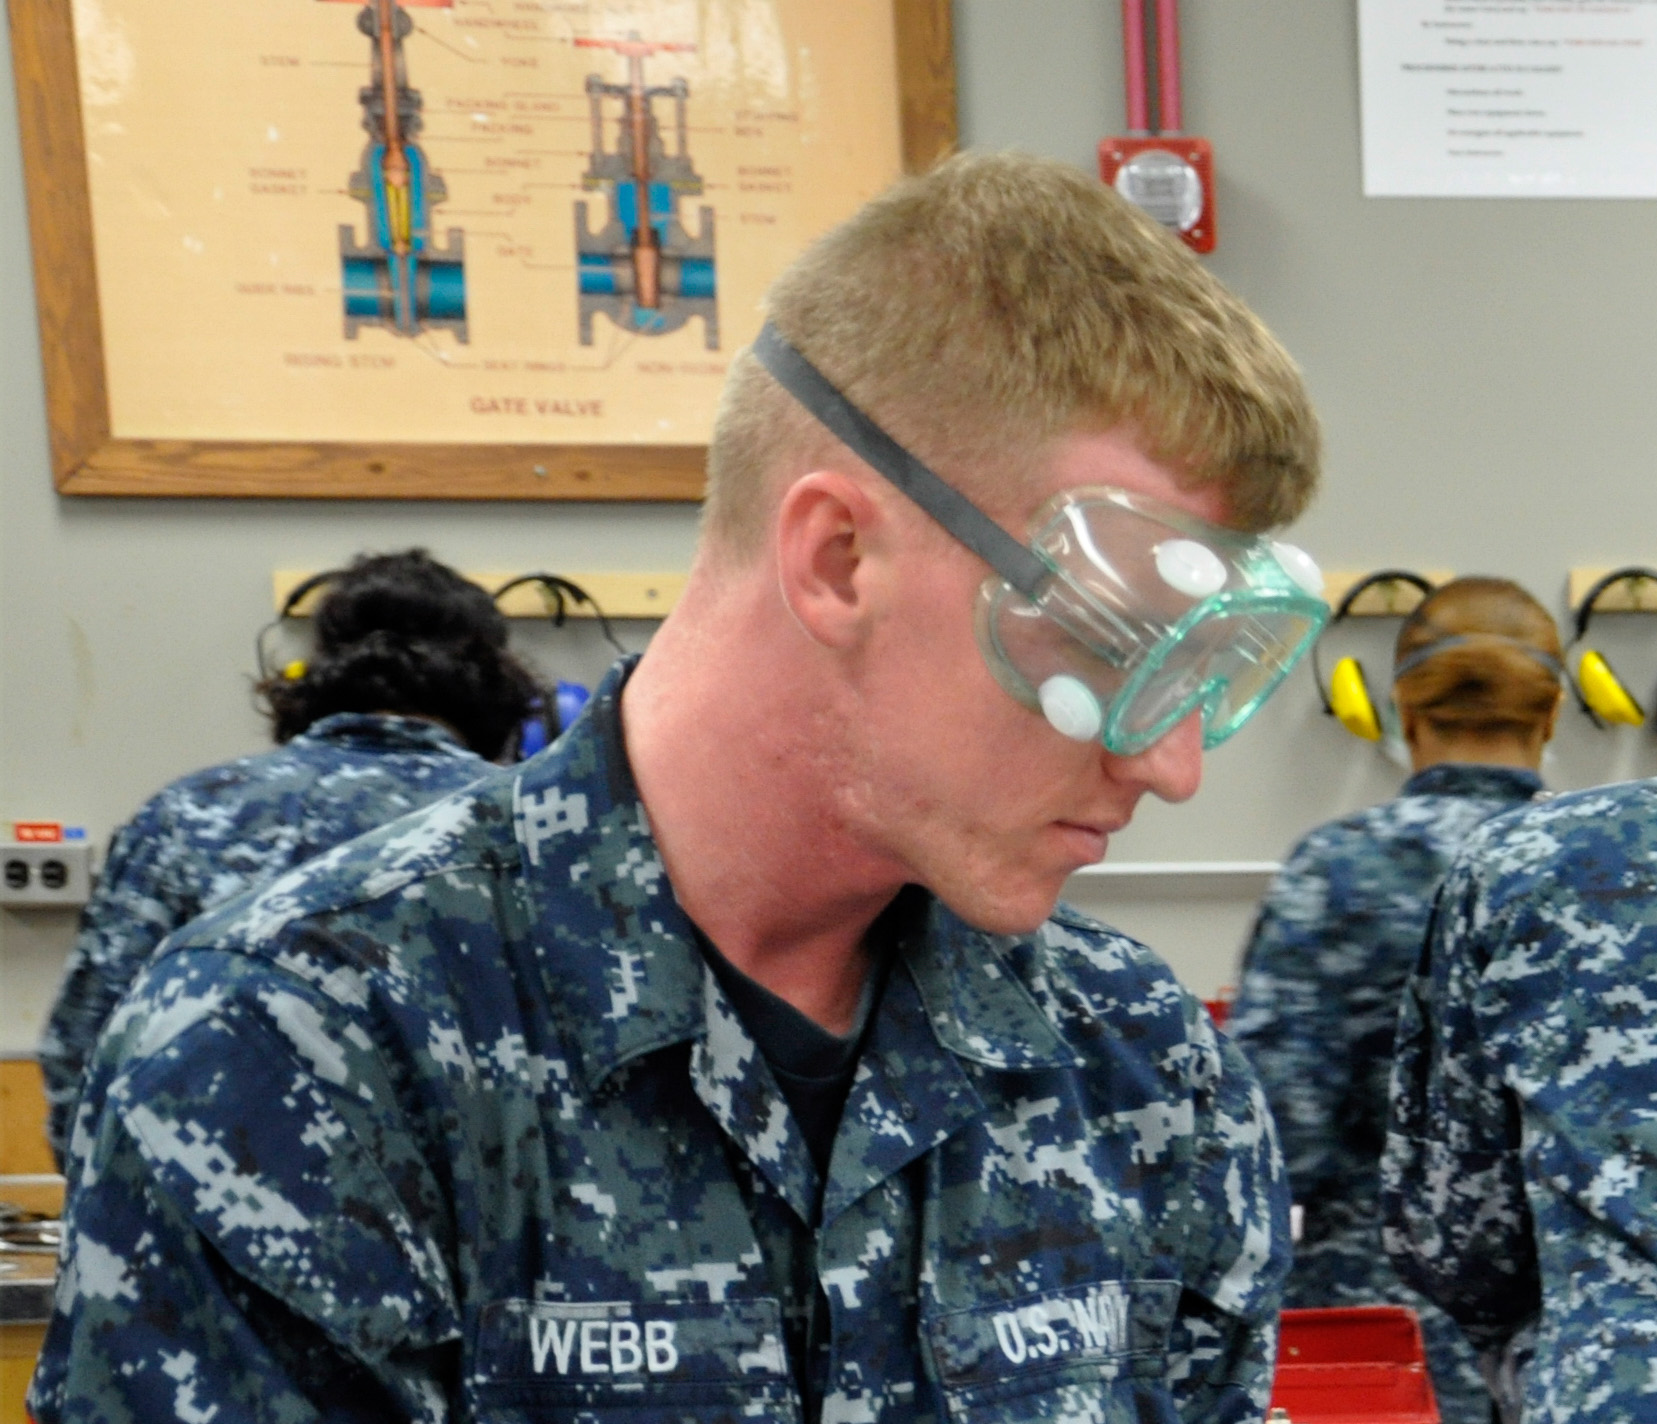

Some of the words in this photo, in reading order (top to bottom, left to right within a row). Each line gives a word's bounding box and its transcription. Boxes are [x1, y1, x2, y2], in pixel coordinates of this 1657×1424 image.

[469, 396, 527, 416] GATE
[533, 398, 603, 417] VALVE
[529, 1317, 679, 1375] WEBB
[992, 1304, 1070, 1364] U.S.
